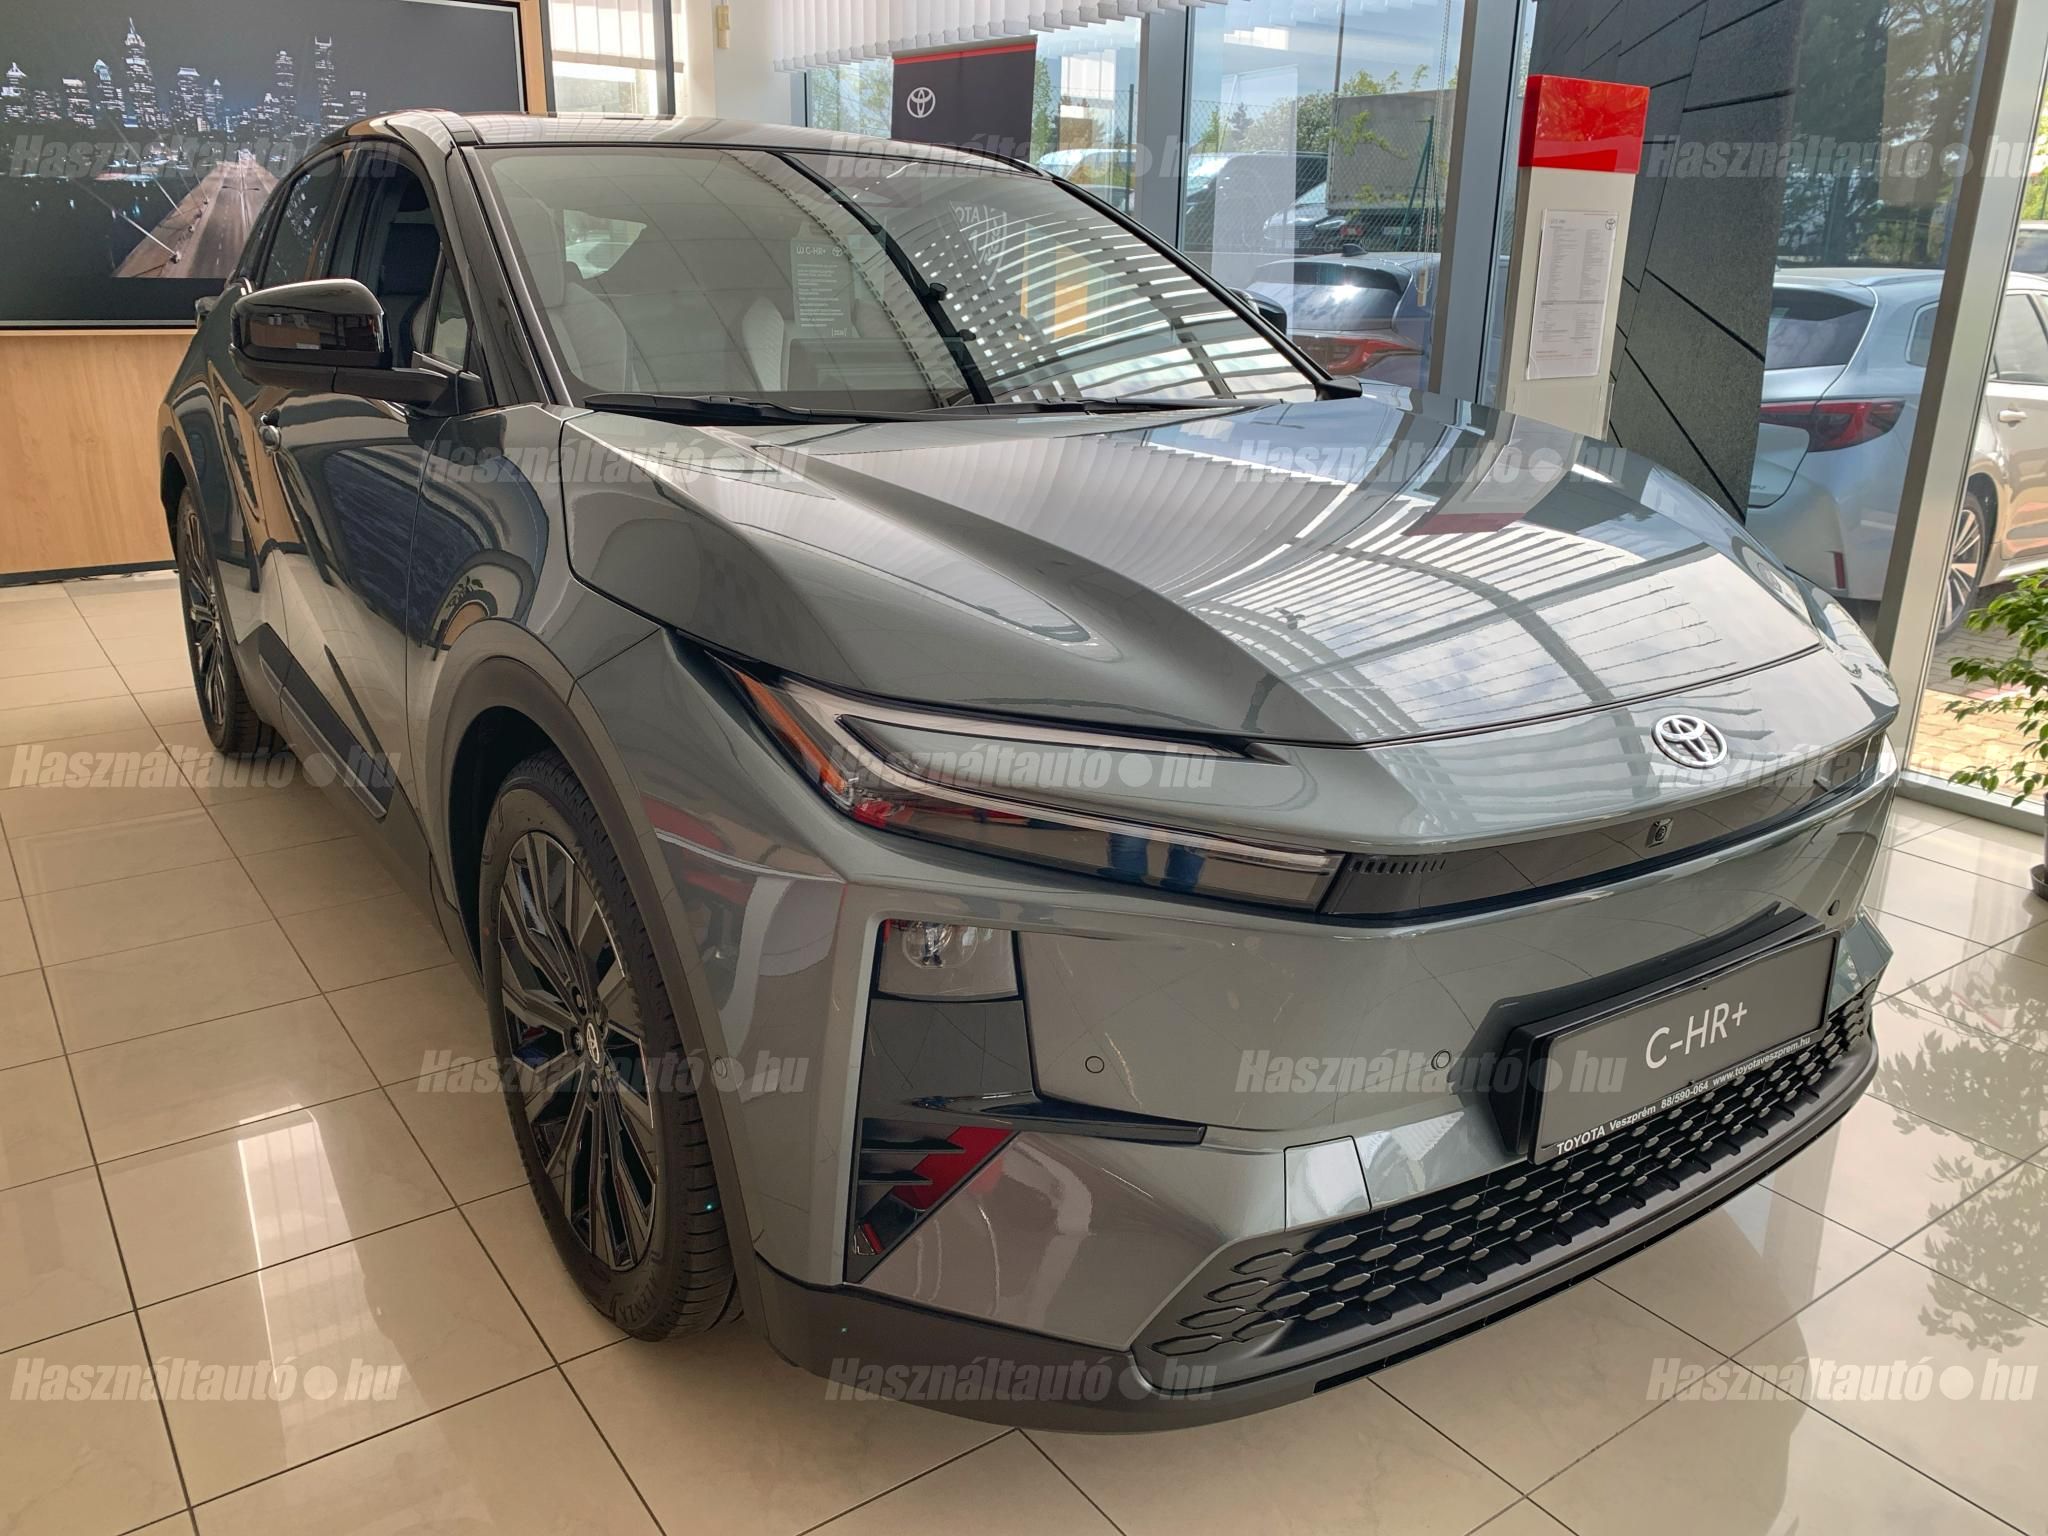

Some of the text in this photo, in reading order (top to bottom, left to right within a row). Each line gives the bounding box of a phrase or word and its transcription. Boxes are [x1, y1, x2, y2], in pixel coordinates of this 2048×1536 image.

[1645, 1001, 1747, 1069] C-HR+
[1557, 1036, 1811, 1155] TOYOTA Veszprém 88/590-064 www.toyotaveszprem.hu
